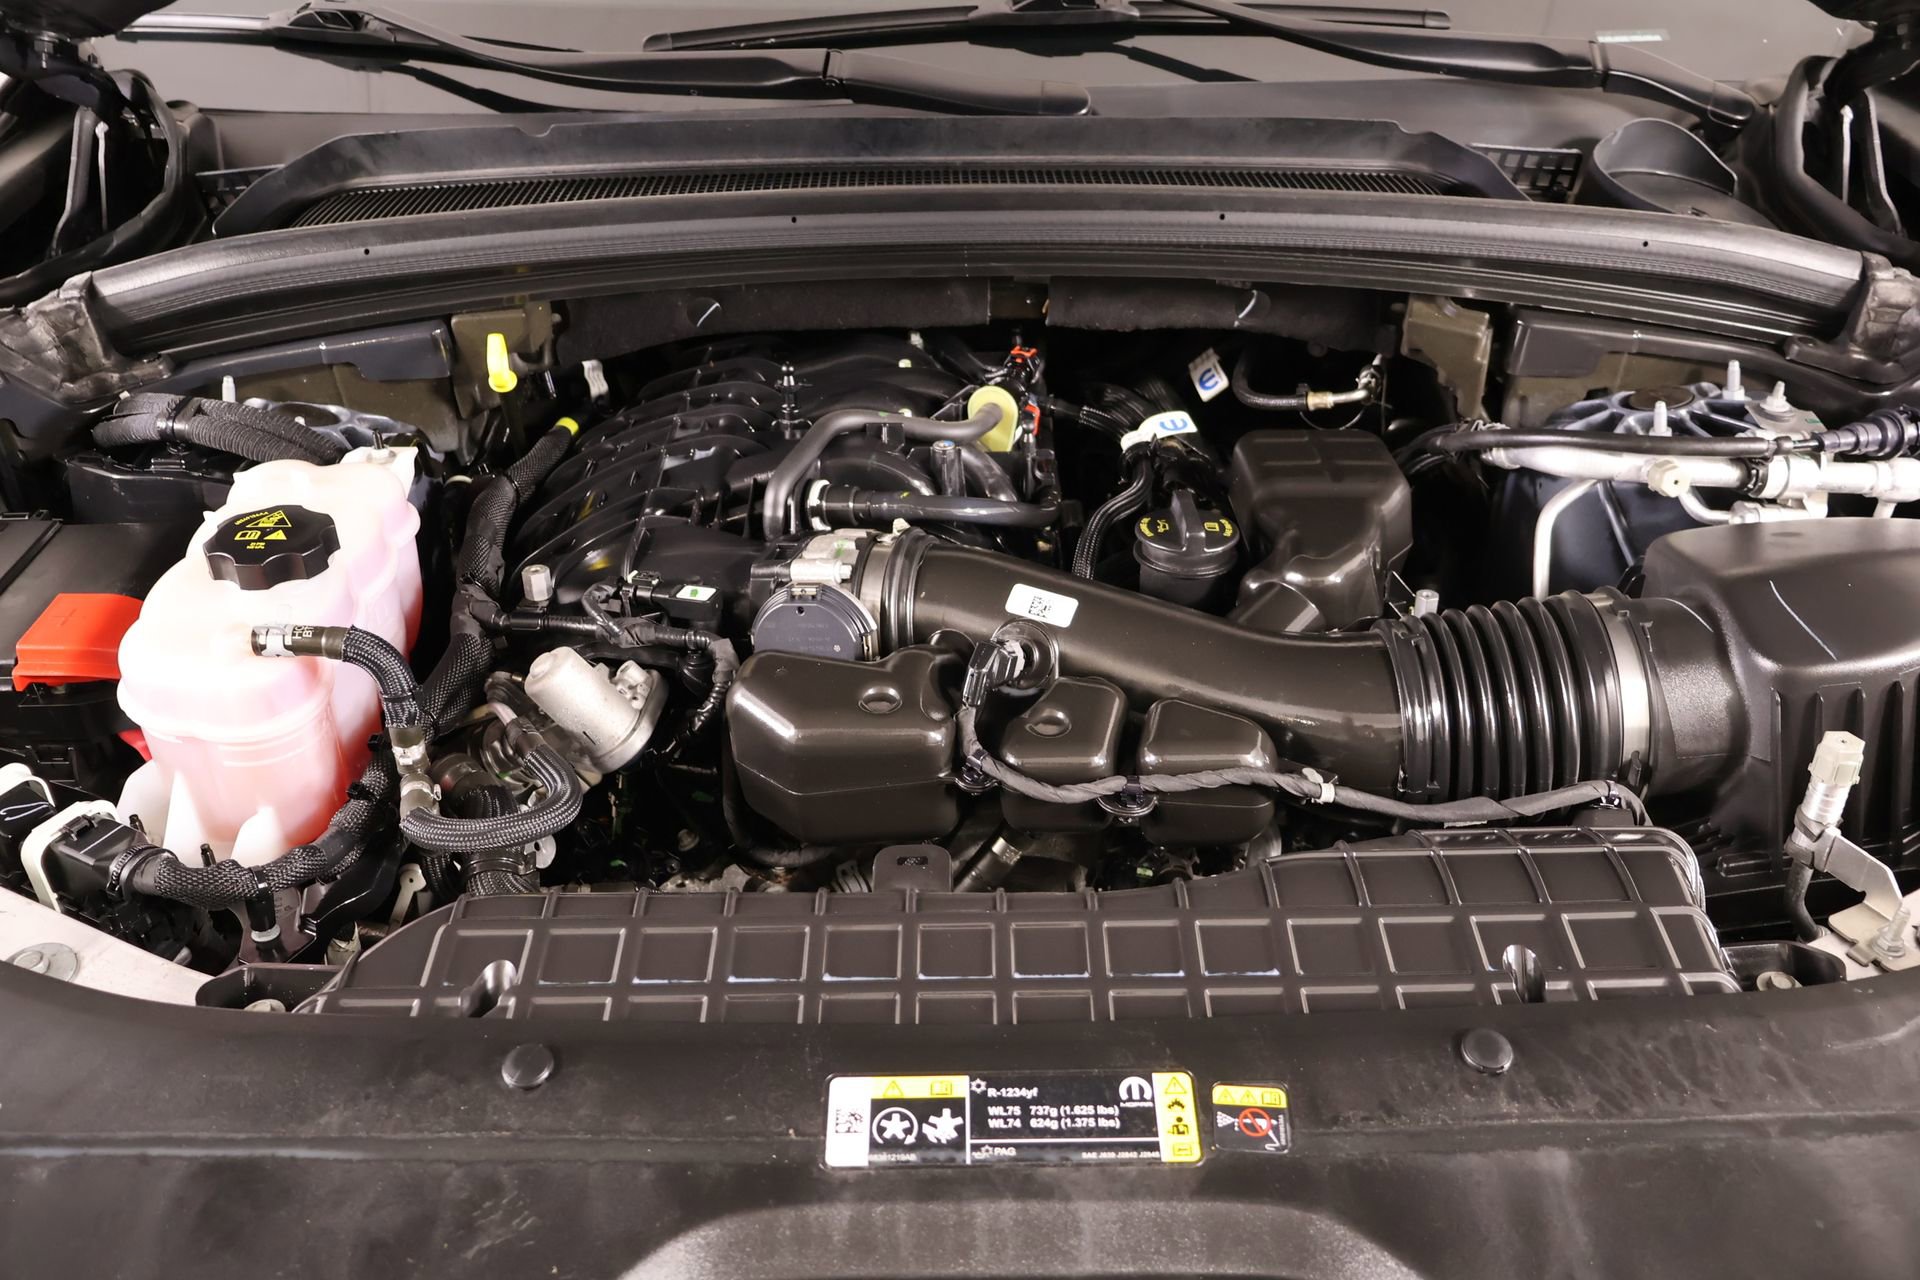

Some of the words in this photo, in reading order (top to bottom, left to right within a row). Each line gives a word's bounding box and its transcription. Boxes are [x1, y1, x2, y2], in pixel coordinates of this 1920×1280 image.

[987, 1087, 1039, 1100] R-1234yf
[987, 1105, 1022, 1117] WL75
[1029, 1105, 1058, 1118] 737g
[1060, 1105, 1095, 1117] (1.625
[1097, 1105, 1120, 1117] lbs)
[987, 1118, 1022, 1129] WL74
[1029, 1118, 1059, 1131] 624g
[1060, 1117, 1096, 1130] (1.375
[1097, 1117, 1121, 1130] lbs)
[993, 1146, 1017, 1157] PAG
